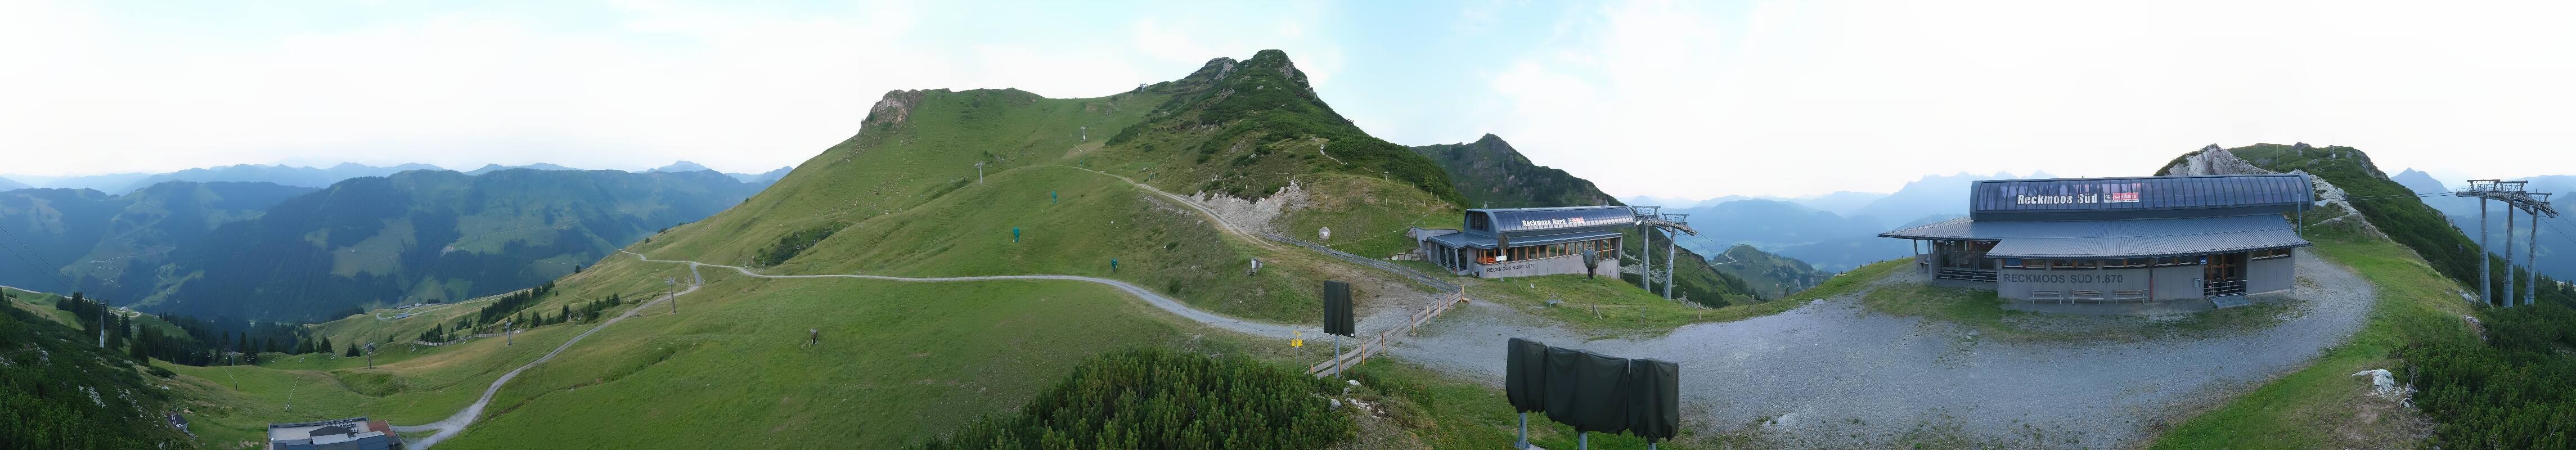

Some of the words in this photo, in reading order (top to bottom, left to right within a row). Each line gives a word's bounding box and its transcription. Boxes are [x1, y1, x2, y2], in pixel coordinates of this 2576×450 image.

[2018, 194, 2073, 204] Reckmoos
[2078, 193, 2097, 204] Süd
[2004, 273, 2065, 283] RECKMOOS
[2070, 273, 2092, 283] SÜD
[2096, 274, 2123, 284] 1.870
